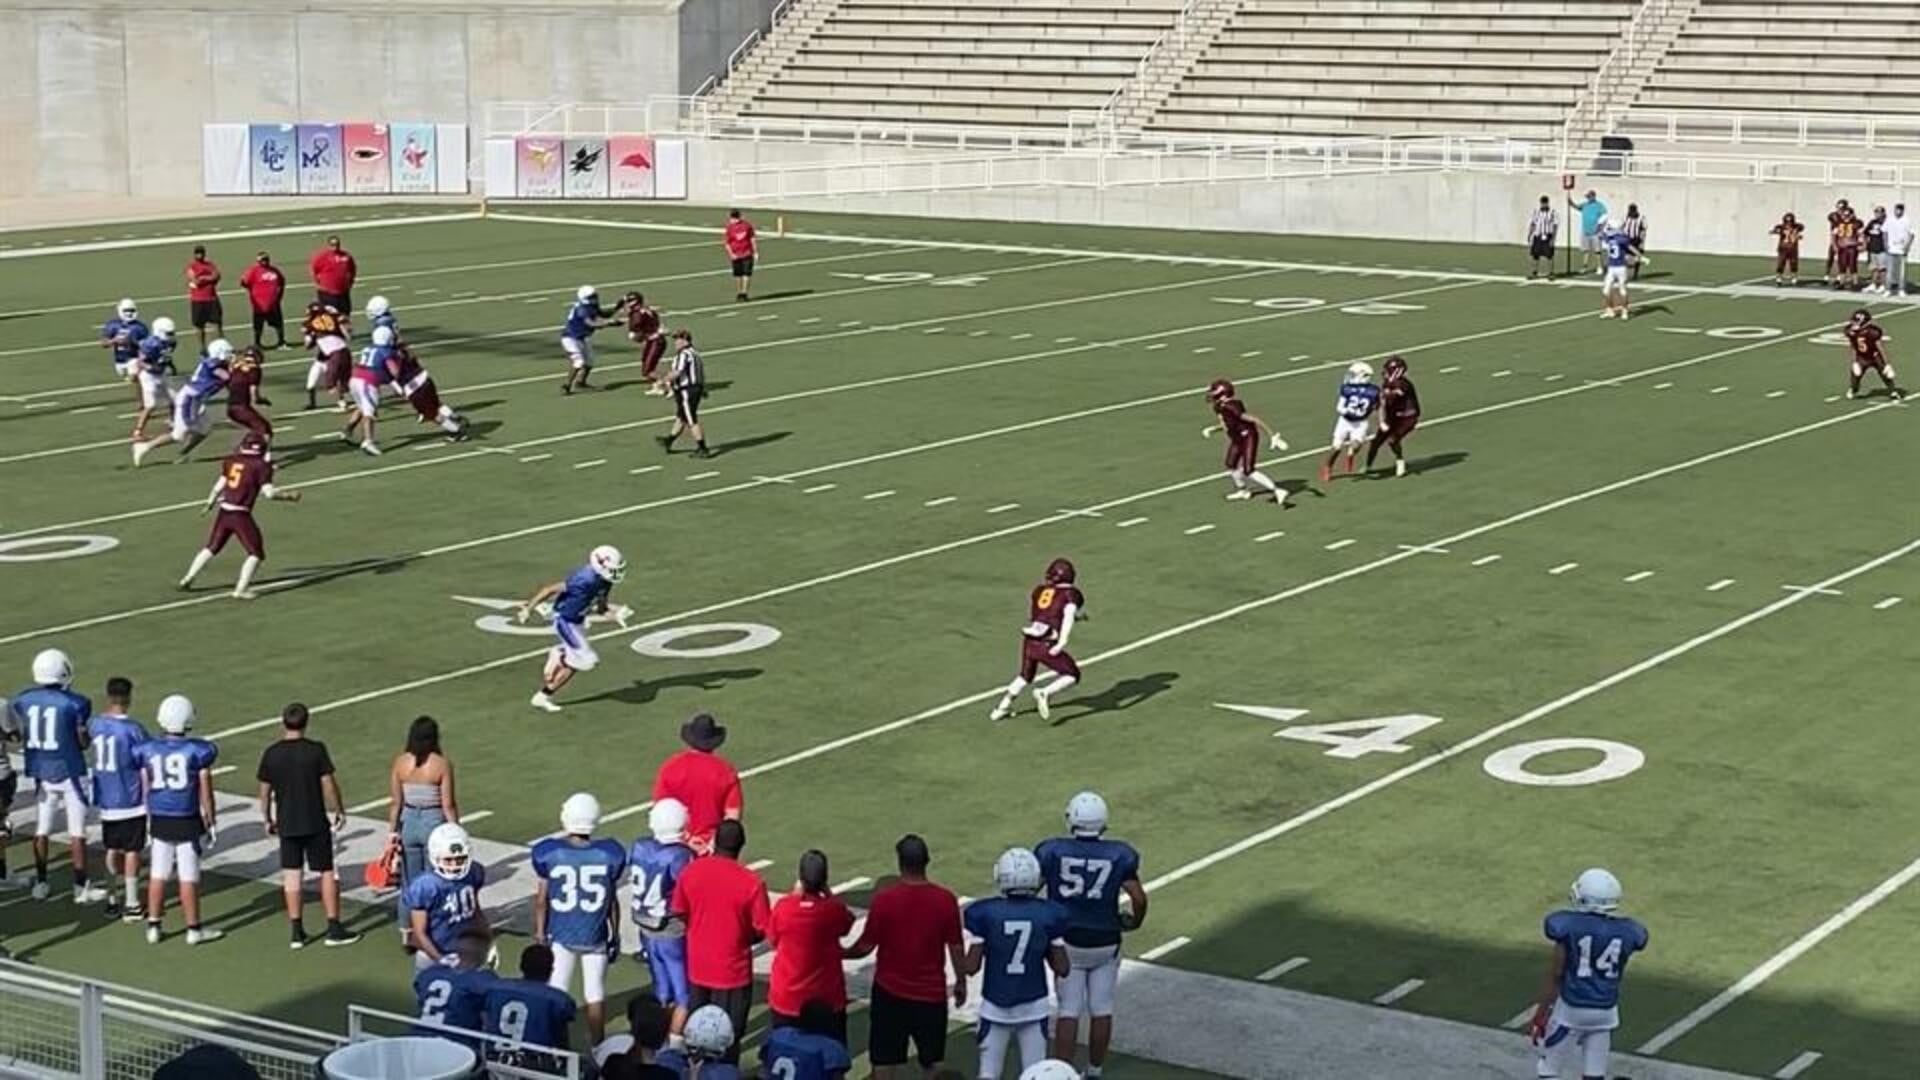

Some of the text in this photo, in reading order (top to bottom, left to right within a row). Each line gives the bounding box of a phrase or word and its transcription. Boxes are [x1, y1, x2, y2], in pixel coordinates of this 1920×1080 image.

[1857, 337, 1867, 352] 5
[1347, 395, 1370, 416] 23
[227, 463, 244, 488] 5
[1037, 588, 1055, 609] 8
[27, 705, 59, 750] 11
[93, 734, 117, 772] 11
[151, 753, 188, 789] 19
[1273, 714, 1645, 786] 40
[550, 865, 607, 912] 35
[631, 864, 667, 917] 24
[1058, 856, 1113, 899] 57
[1004, 920, 1032, 974] 7
[1577, 935, 1622, 977] 14
[421, 980, 452, 1024] 2
[499, 1001, 528, 1050] 9
